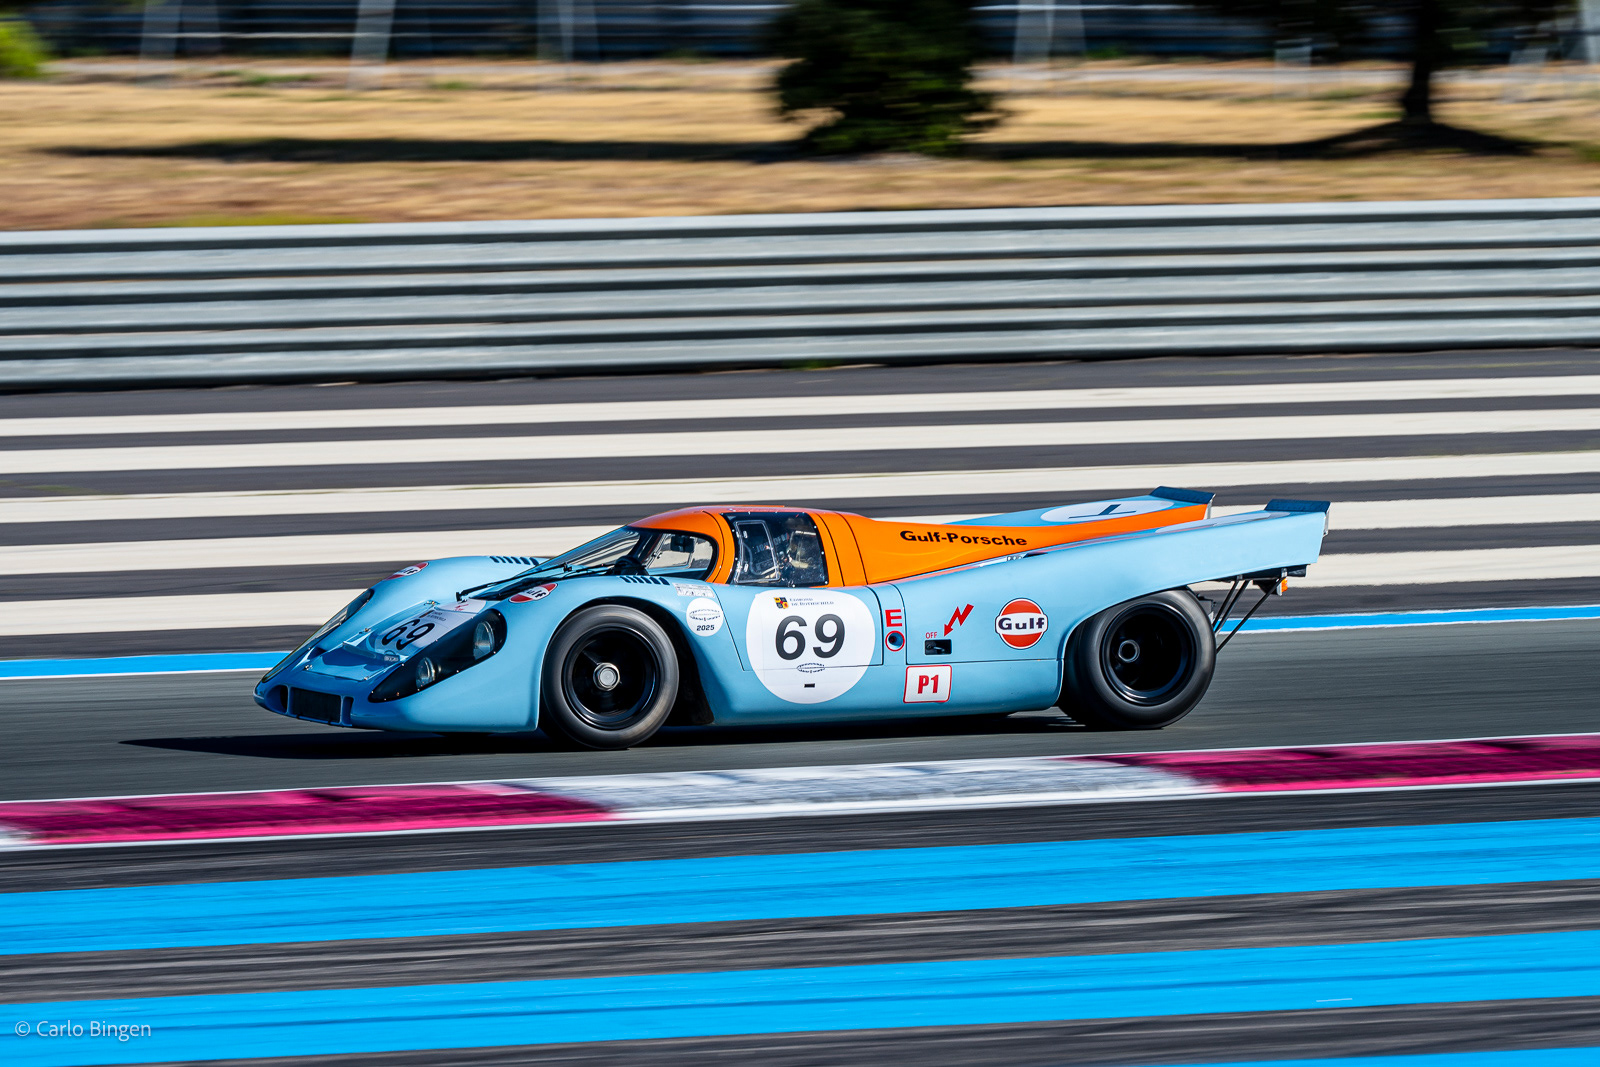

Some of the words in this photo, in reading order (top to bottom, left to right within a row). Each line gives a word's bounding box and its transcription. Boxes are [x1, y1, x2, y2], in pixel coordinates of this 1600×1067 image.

[899, 530, 1028, 546] Gulf-Porsche
[884, 608, 903, 628] E
[998, 617, 1045, 631] Gulf
[381, 618, 436, 651] 69
[775, 613, 846, 661] 69
[925, 631, 938, 639] OFF
[917, 674, 939, 694] P1
